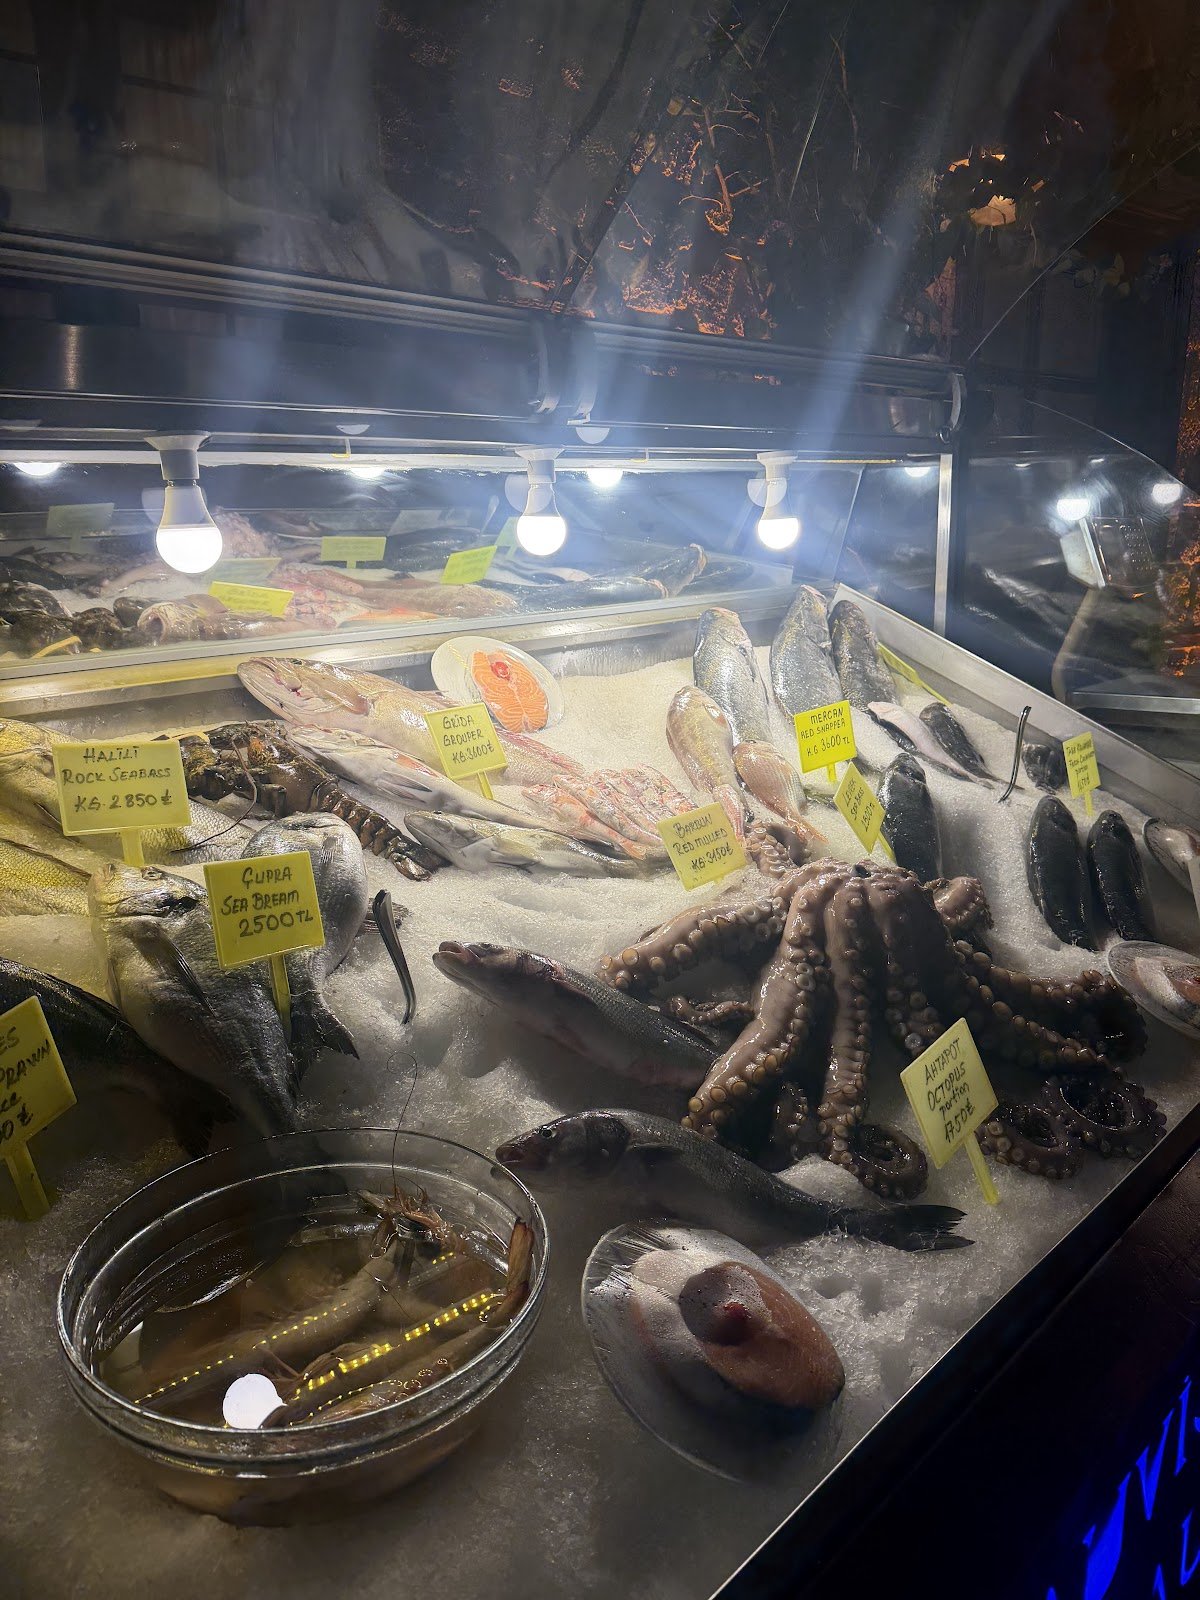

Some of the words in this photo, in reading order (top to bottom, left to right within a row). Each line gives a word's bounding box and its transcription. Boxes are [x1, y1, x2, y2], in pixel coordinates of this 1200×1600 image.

[811, 706, 844, 724] MERCAN
[443, 728, 485, 747] GROUPER
[801, 728, 815, 740] RED
[816, 718, 846, 735] SNAPPER
[61, 768, 106, 786] ROCK
[672, 813, 713, 839] BARBUN
[672, 842, 695, 856] RED
[220, 895, 249, 916] SEA
[252, 889, 299, 910] BREAM
[924, 1036, 960, 1086] AHTAPOT
[927, 1061, 966, 1112] OCTOPUS
